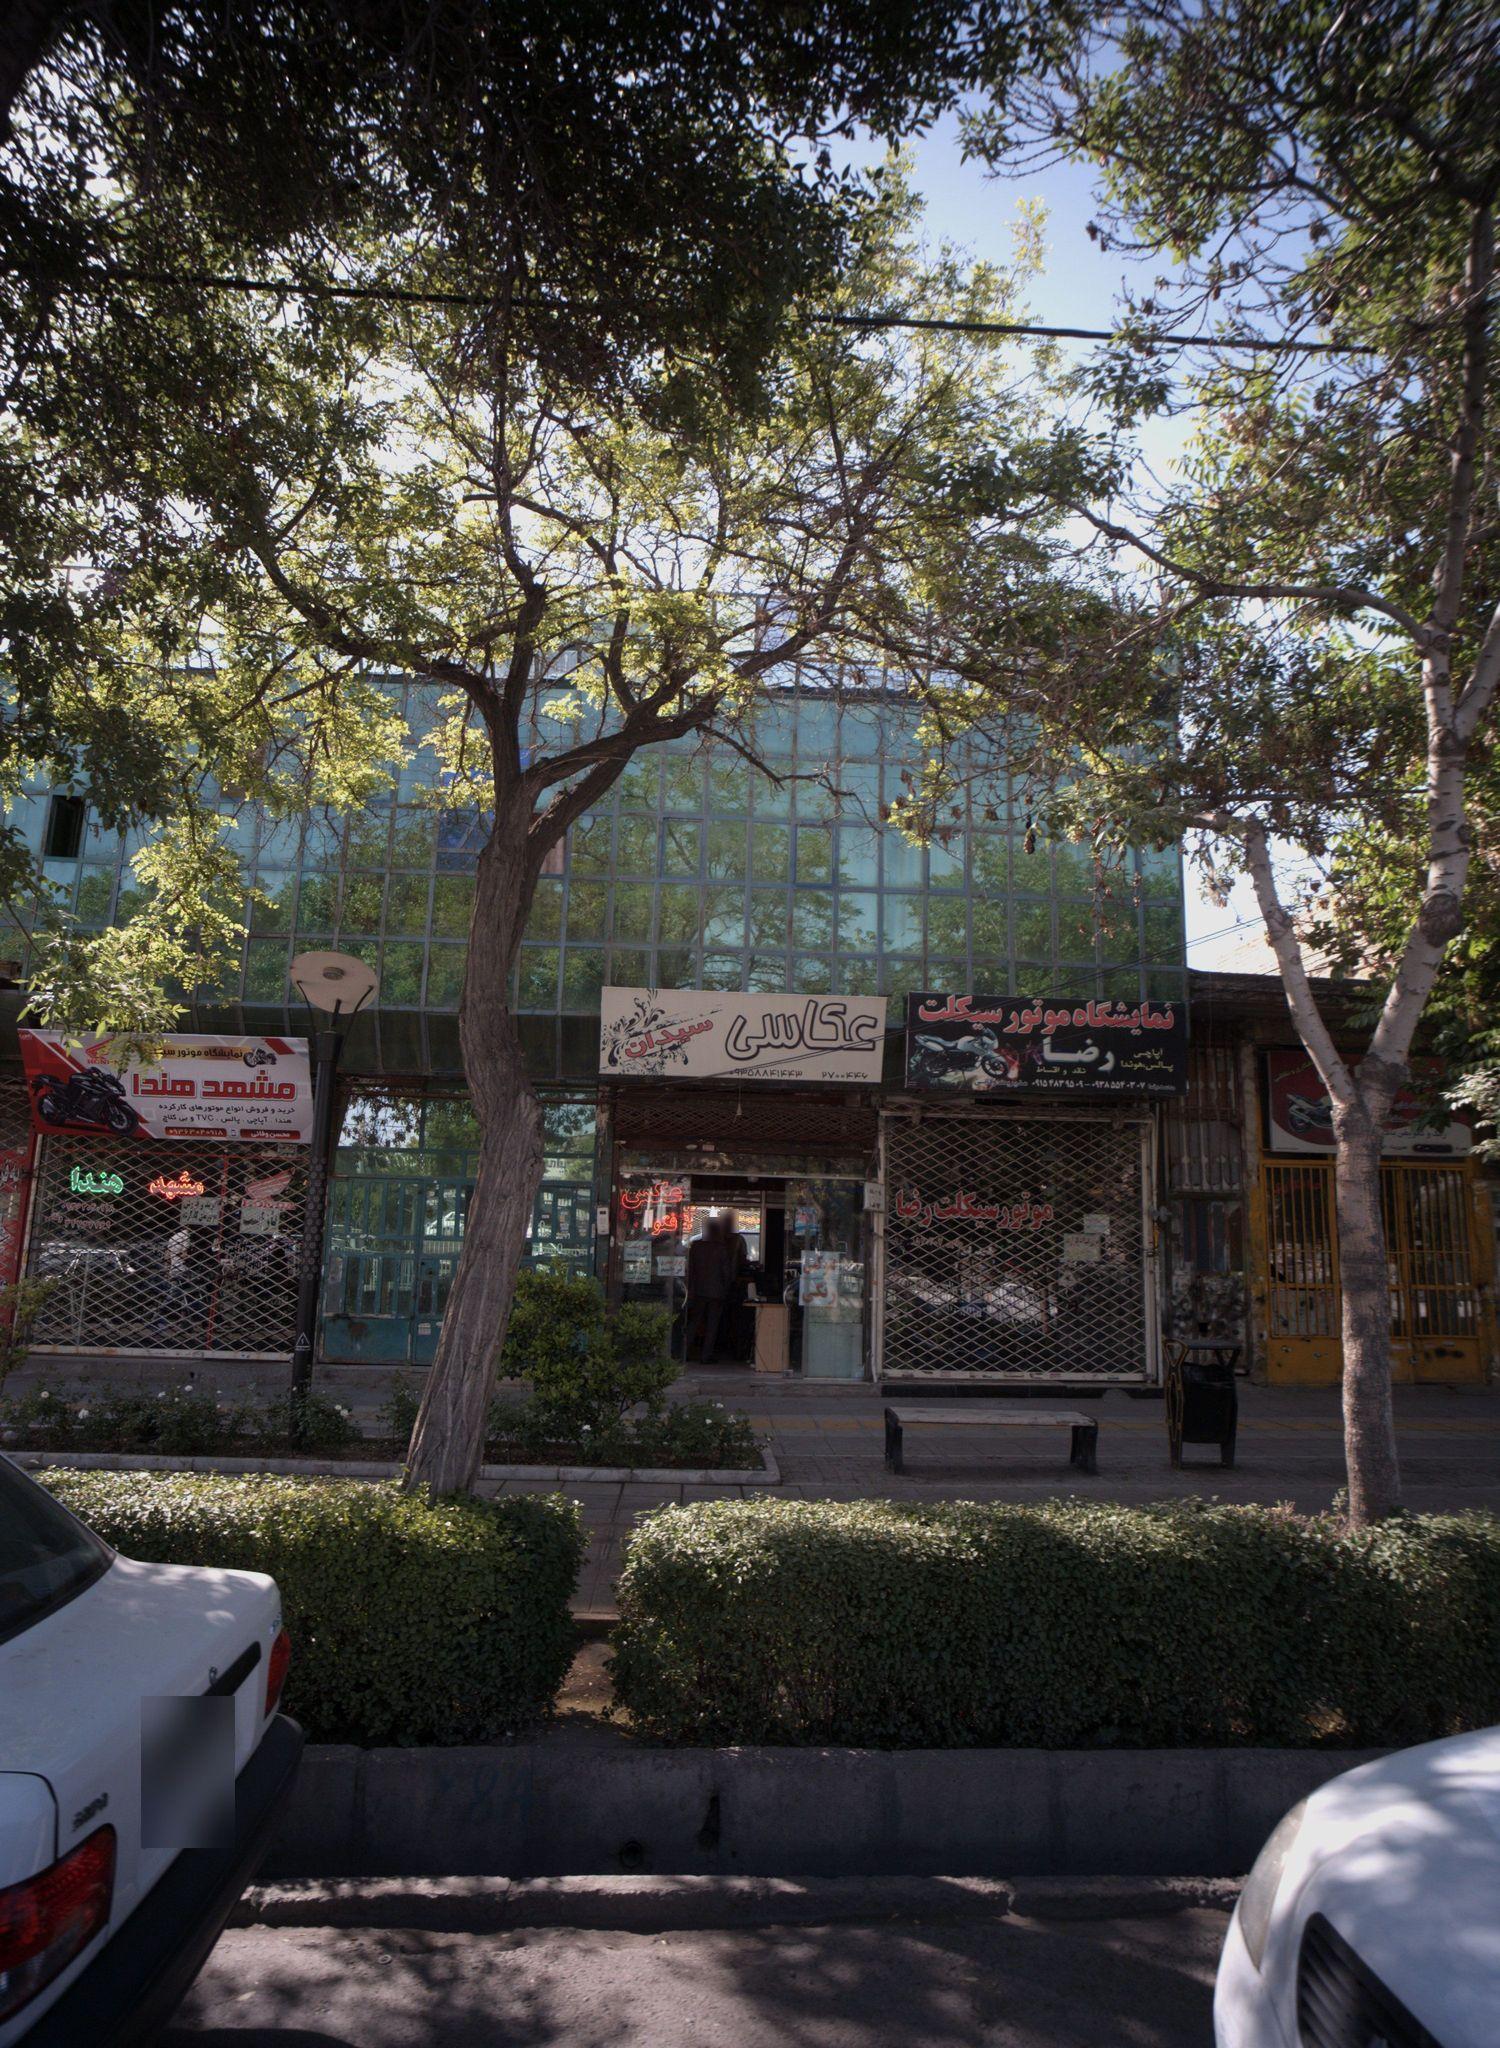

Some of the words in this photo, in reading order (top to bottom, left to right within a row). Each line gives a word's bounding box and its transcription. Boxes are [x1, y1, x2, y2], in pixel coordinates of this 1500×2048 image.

[726, 999, 878, 1061] عکاسی
[918, 994, 1003, 1031] سیکلت
[1003, 998, 1071, 1035] موتور
[1072, 1000, 1175, 1036] نمایشگاه
[177, 1047, 202, 1058] موتور
[204, 1048, 243, 1060] نمایشگاه
[624, 1019, 714, 1058] سیدان
[1043, 1036, 1116, 1075] رضا
[133, 1072, 196, 1098] هندا
[202, 1070, 296, 1100] مشهد
[246, 1106, 268, 1114] فروش
[71, 1166, 124, 1194] هندا
[895, 1188, 932, 1228] رضا
